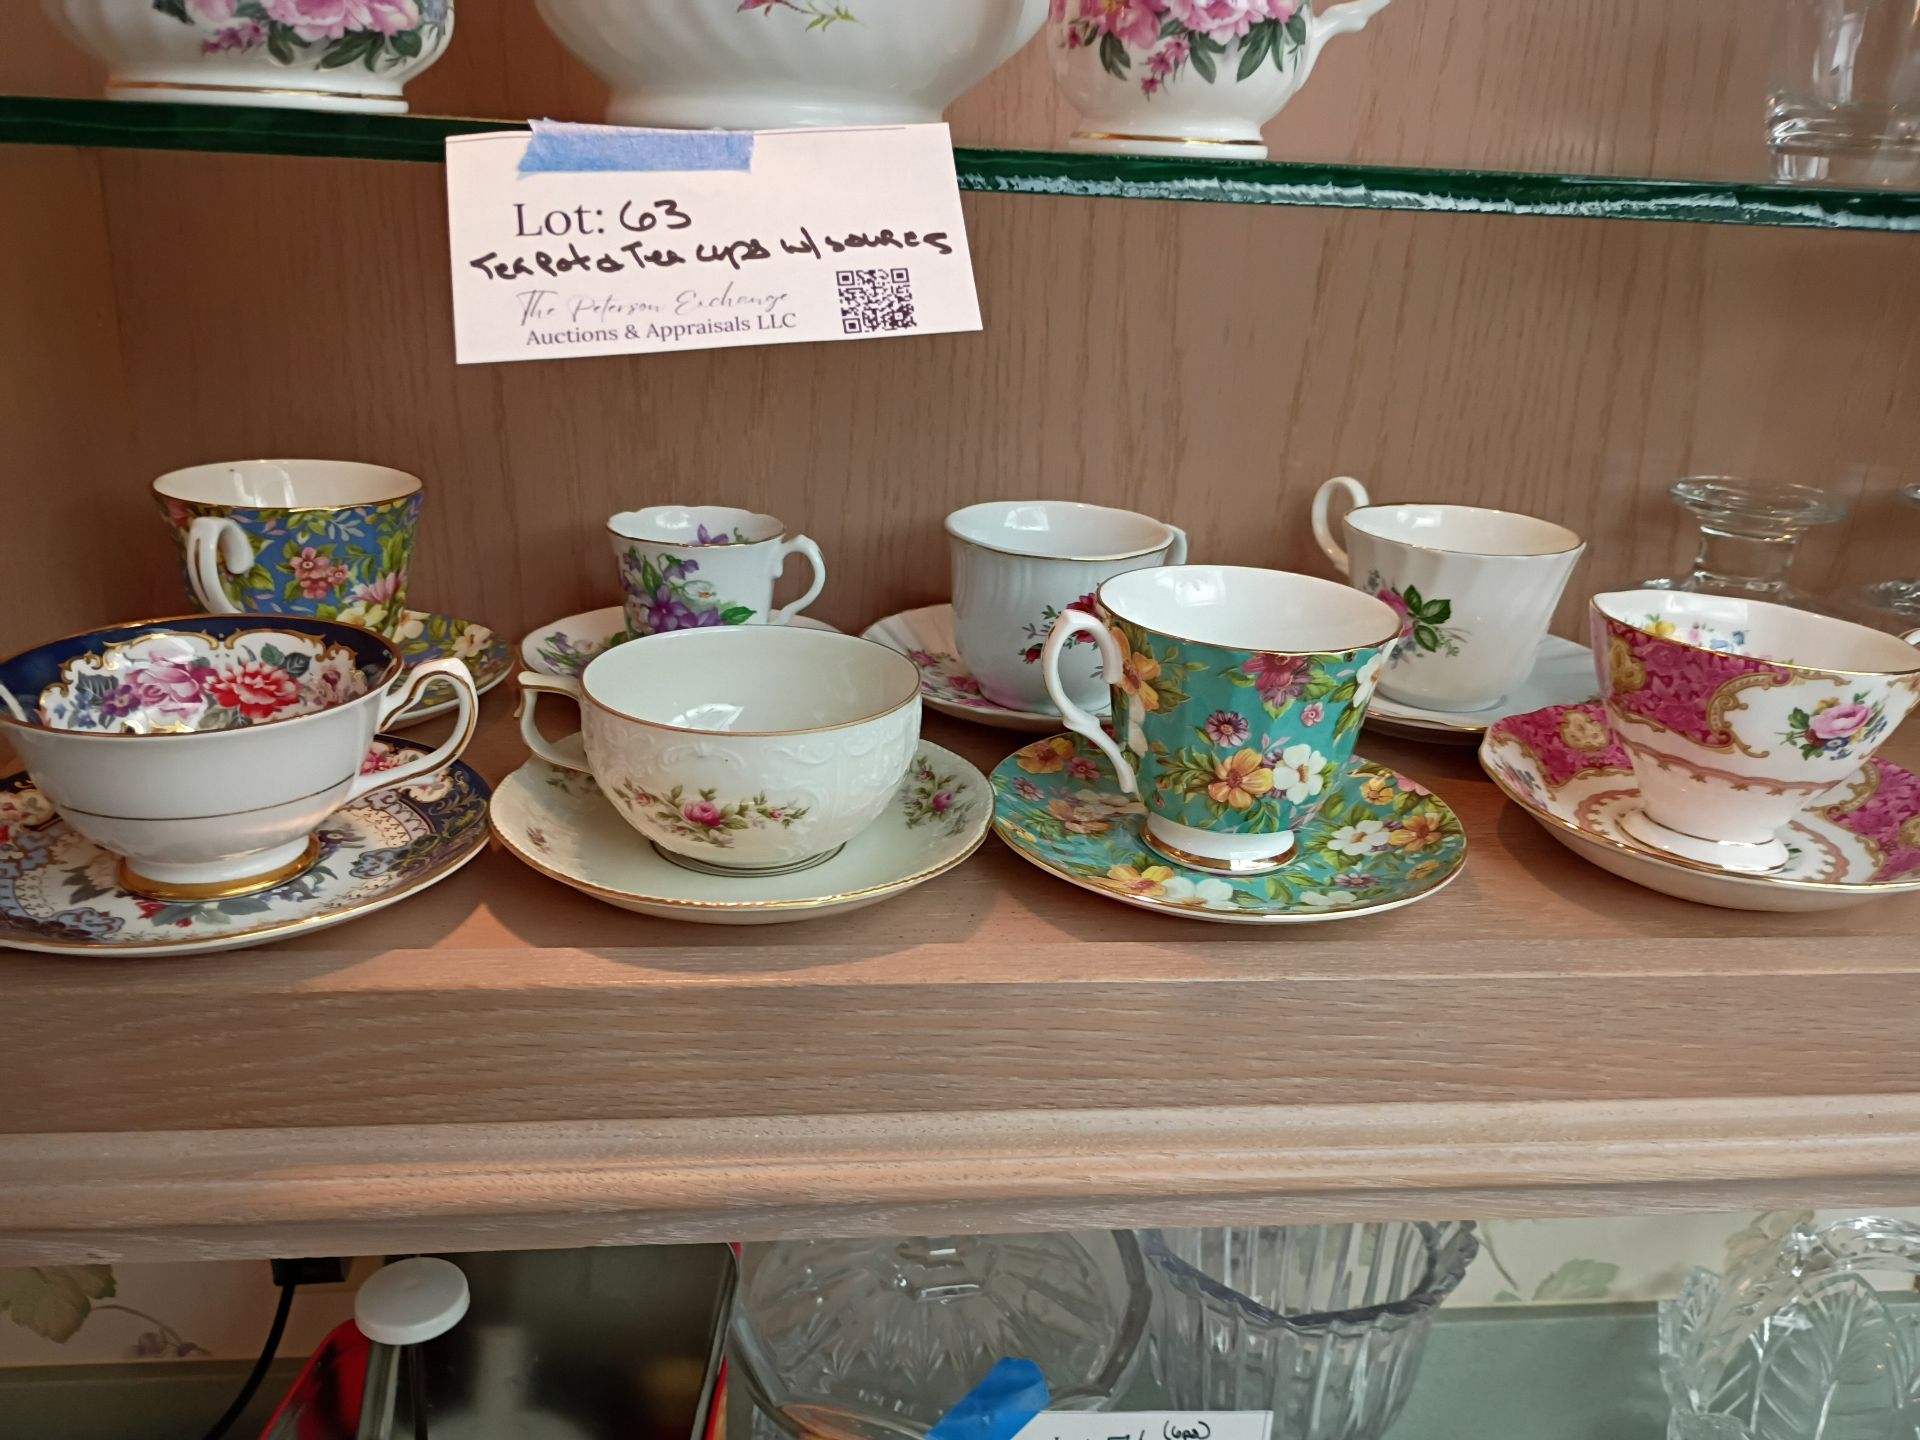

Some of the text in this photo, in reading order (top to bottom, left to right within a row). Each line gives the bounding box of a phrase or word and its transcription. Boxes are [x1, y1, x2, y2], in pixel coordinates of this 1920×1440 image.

[514, 199, 692, 237] Lot: 63
[516, 281, 789, 326] The Peterson Exchange
[526, 312, 797, 346] Auctions & Appraisals LLC
